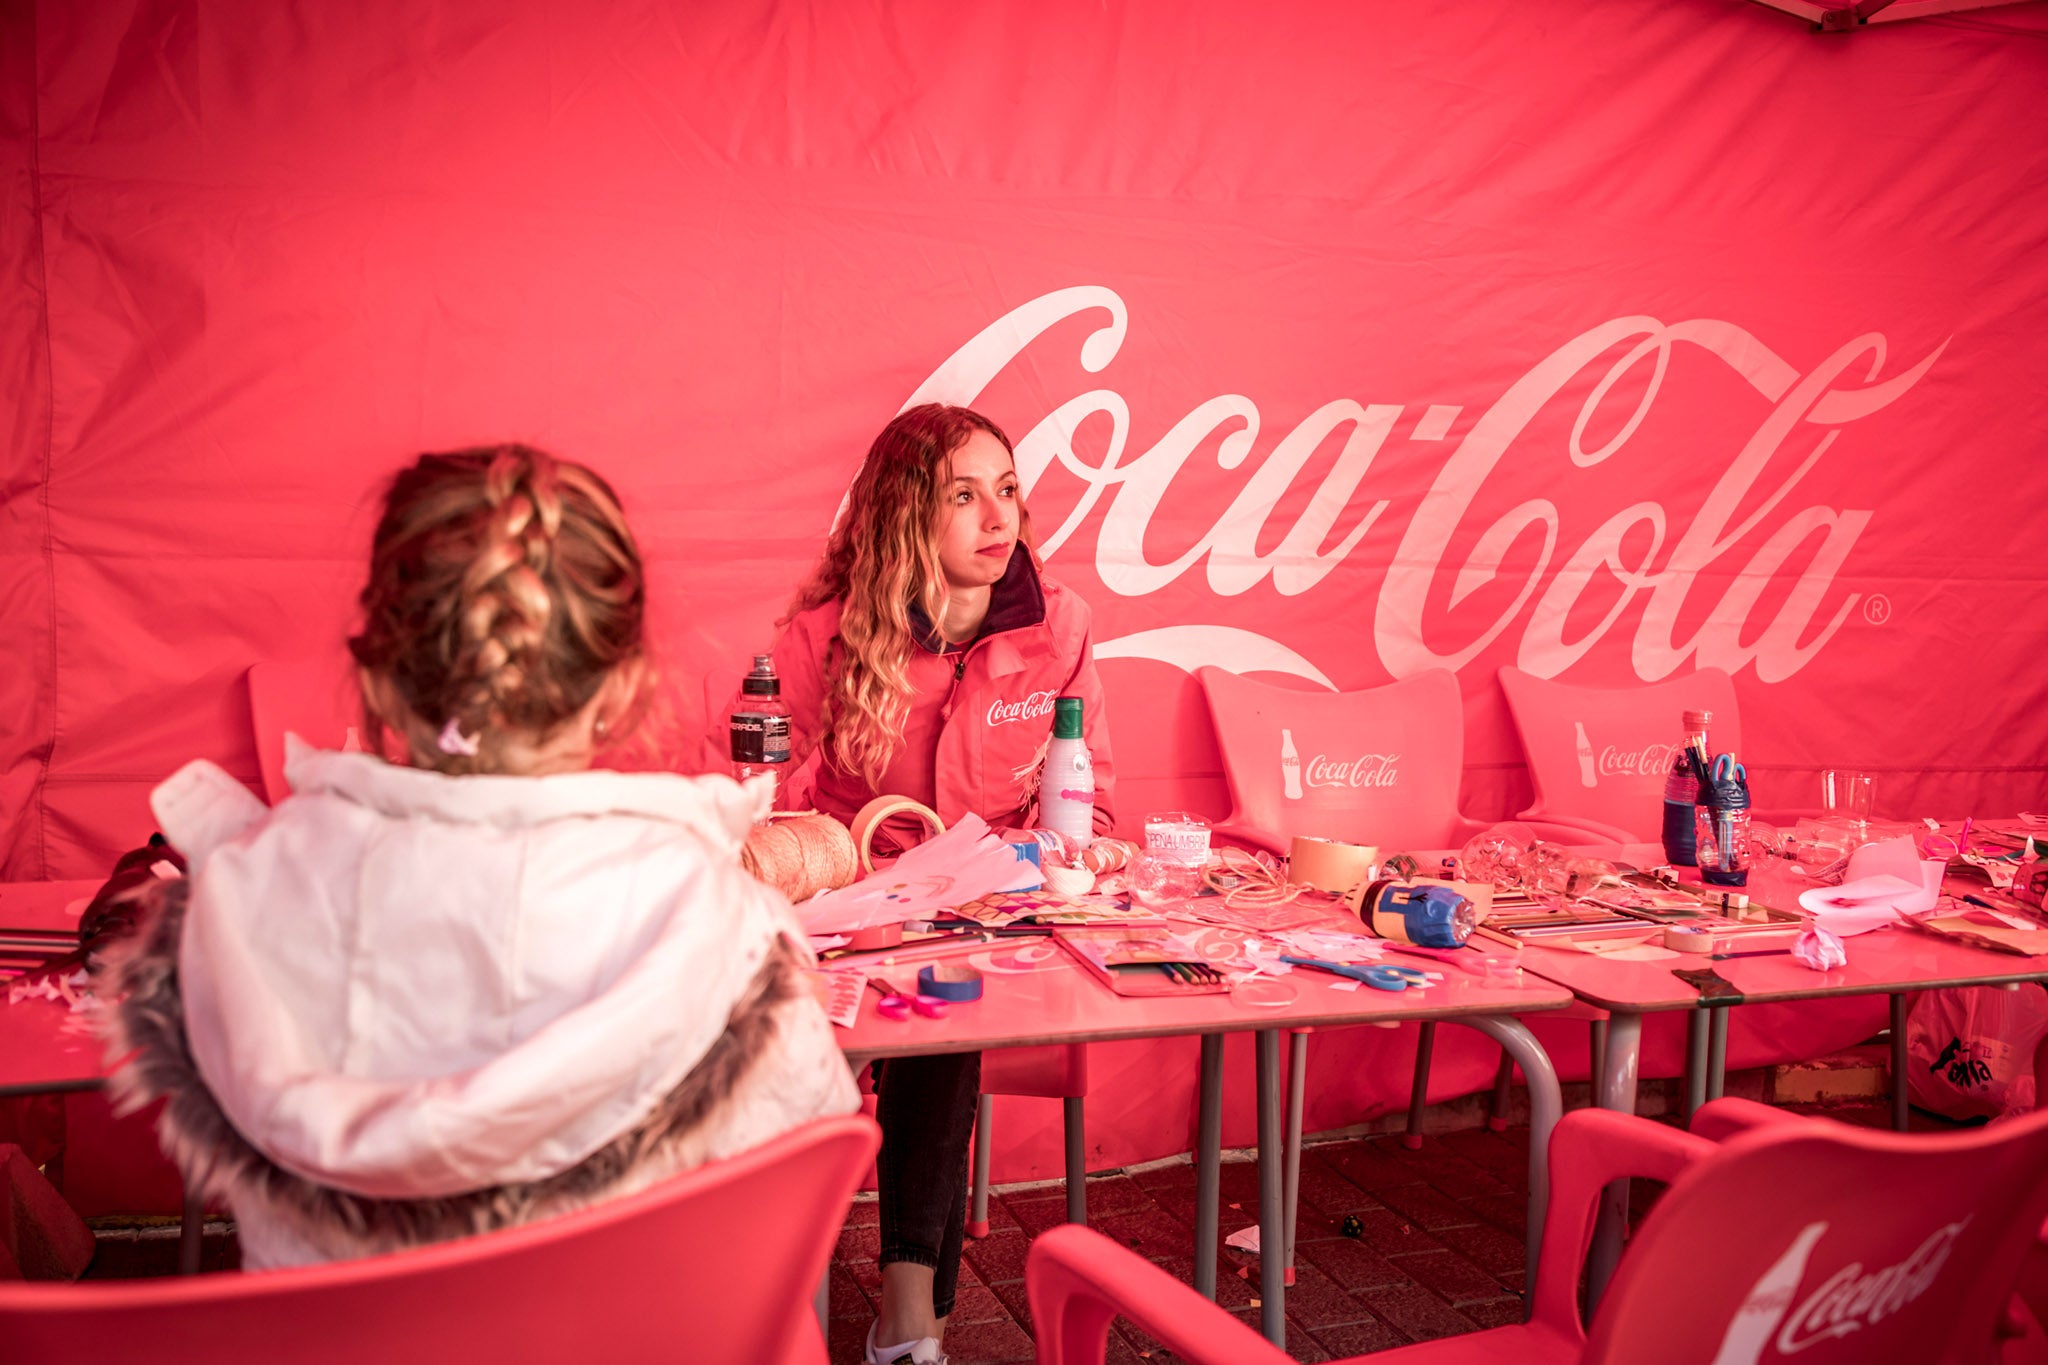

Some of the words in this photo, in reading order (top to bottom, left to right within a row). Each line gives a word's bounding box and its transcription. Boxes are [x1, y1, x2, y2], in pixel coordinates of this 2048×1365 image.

[830, 285, 1953, 690] Coca-Cola
[986, 688, 1059, 727] Coca-Cola
[1305, 753, 1401, 788] Coca-Cola
[1599, 743, 1680, 776] Coca-Col
